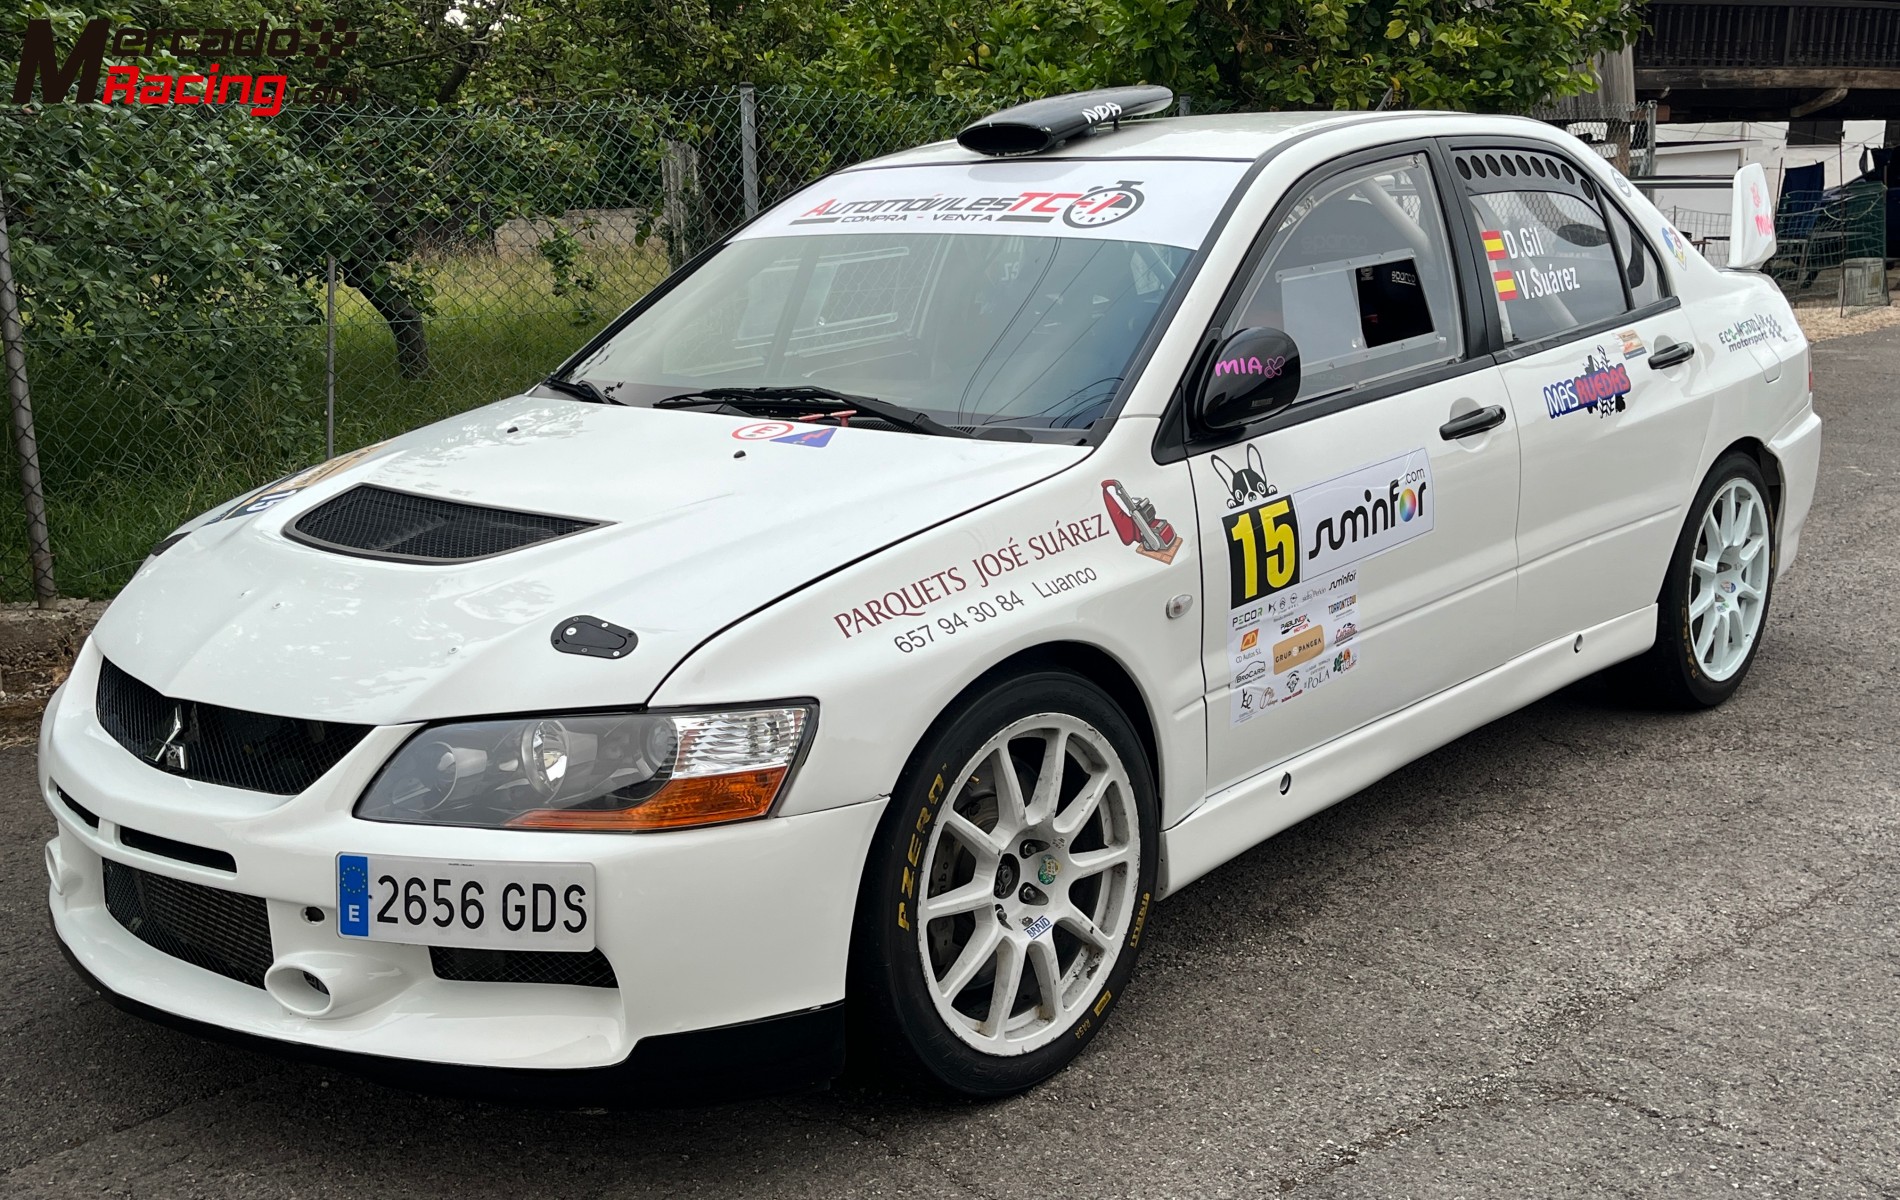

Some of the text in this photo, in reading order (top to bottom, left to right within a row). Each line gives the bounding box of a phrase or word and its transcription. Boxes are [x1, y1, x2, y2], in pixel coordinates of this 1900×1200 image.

[841, 213, 909, 224] COMPRA
[931, 213, 994, 223] VENTA
[1502, 227, 1545, 260] D.Gil
[1516, 263, 1581, 300] V.Suárez
[1215, 356, 1264, 378] MIA
[1231, 500, 1296, 599] 15
[833, 512, 1110, 638] PARQUETS JOSÉ SUÁREZ
[893, 566, 1098, 654] 657 94 30 84 Luanco
[348, 874, 588, 934] E 2656 GDS
[1026, 917, 1052, 938] BRAID
